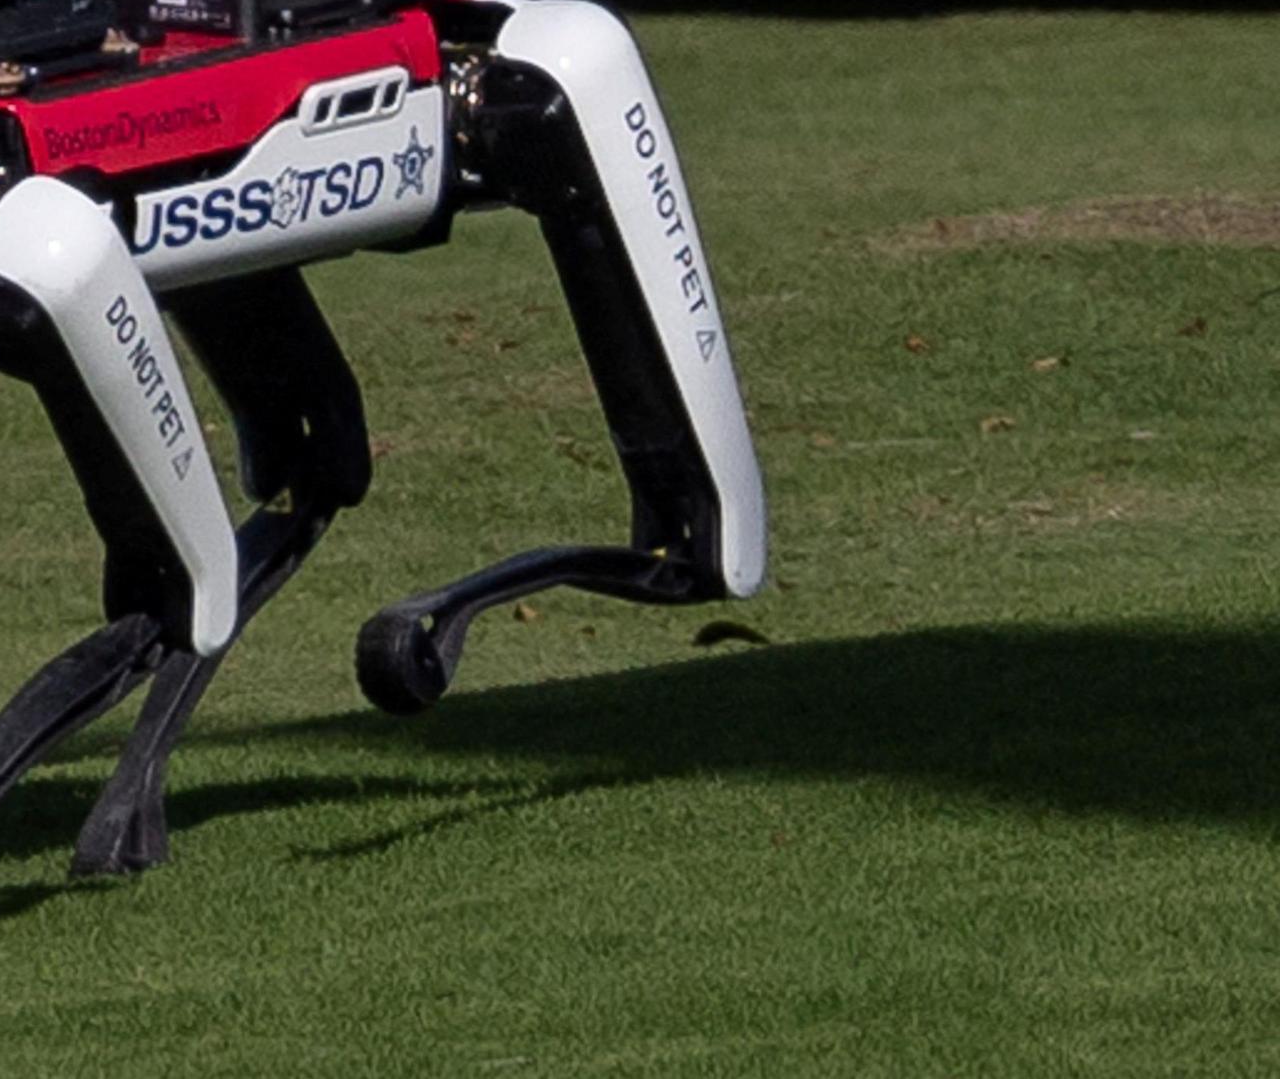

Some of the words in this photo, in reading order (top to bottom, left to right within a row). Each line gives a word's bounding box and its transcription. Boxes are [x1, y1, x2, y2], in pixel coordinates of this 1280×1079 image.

[298, 156, 385, 222] TSD
[624, 102, 657, 159] DO
[647, 163, 685, 237] NOT
[674, 245, 709, 315] PET
[106, 294, 137, 344] DO
[127, 336, 164, 398] NOT
[152, 391, 185, 448] PET
